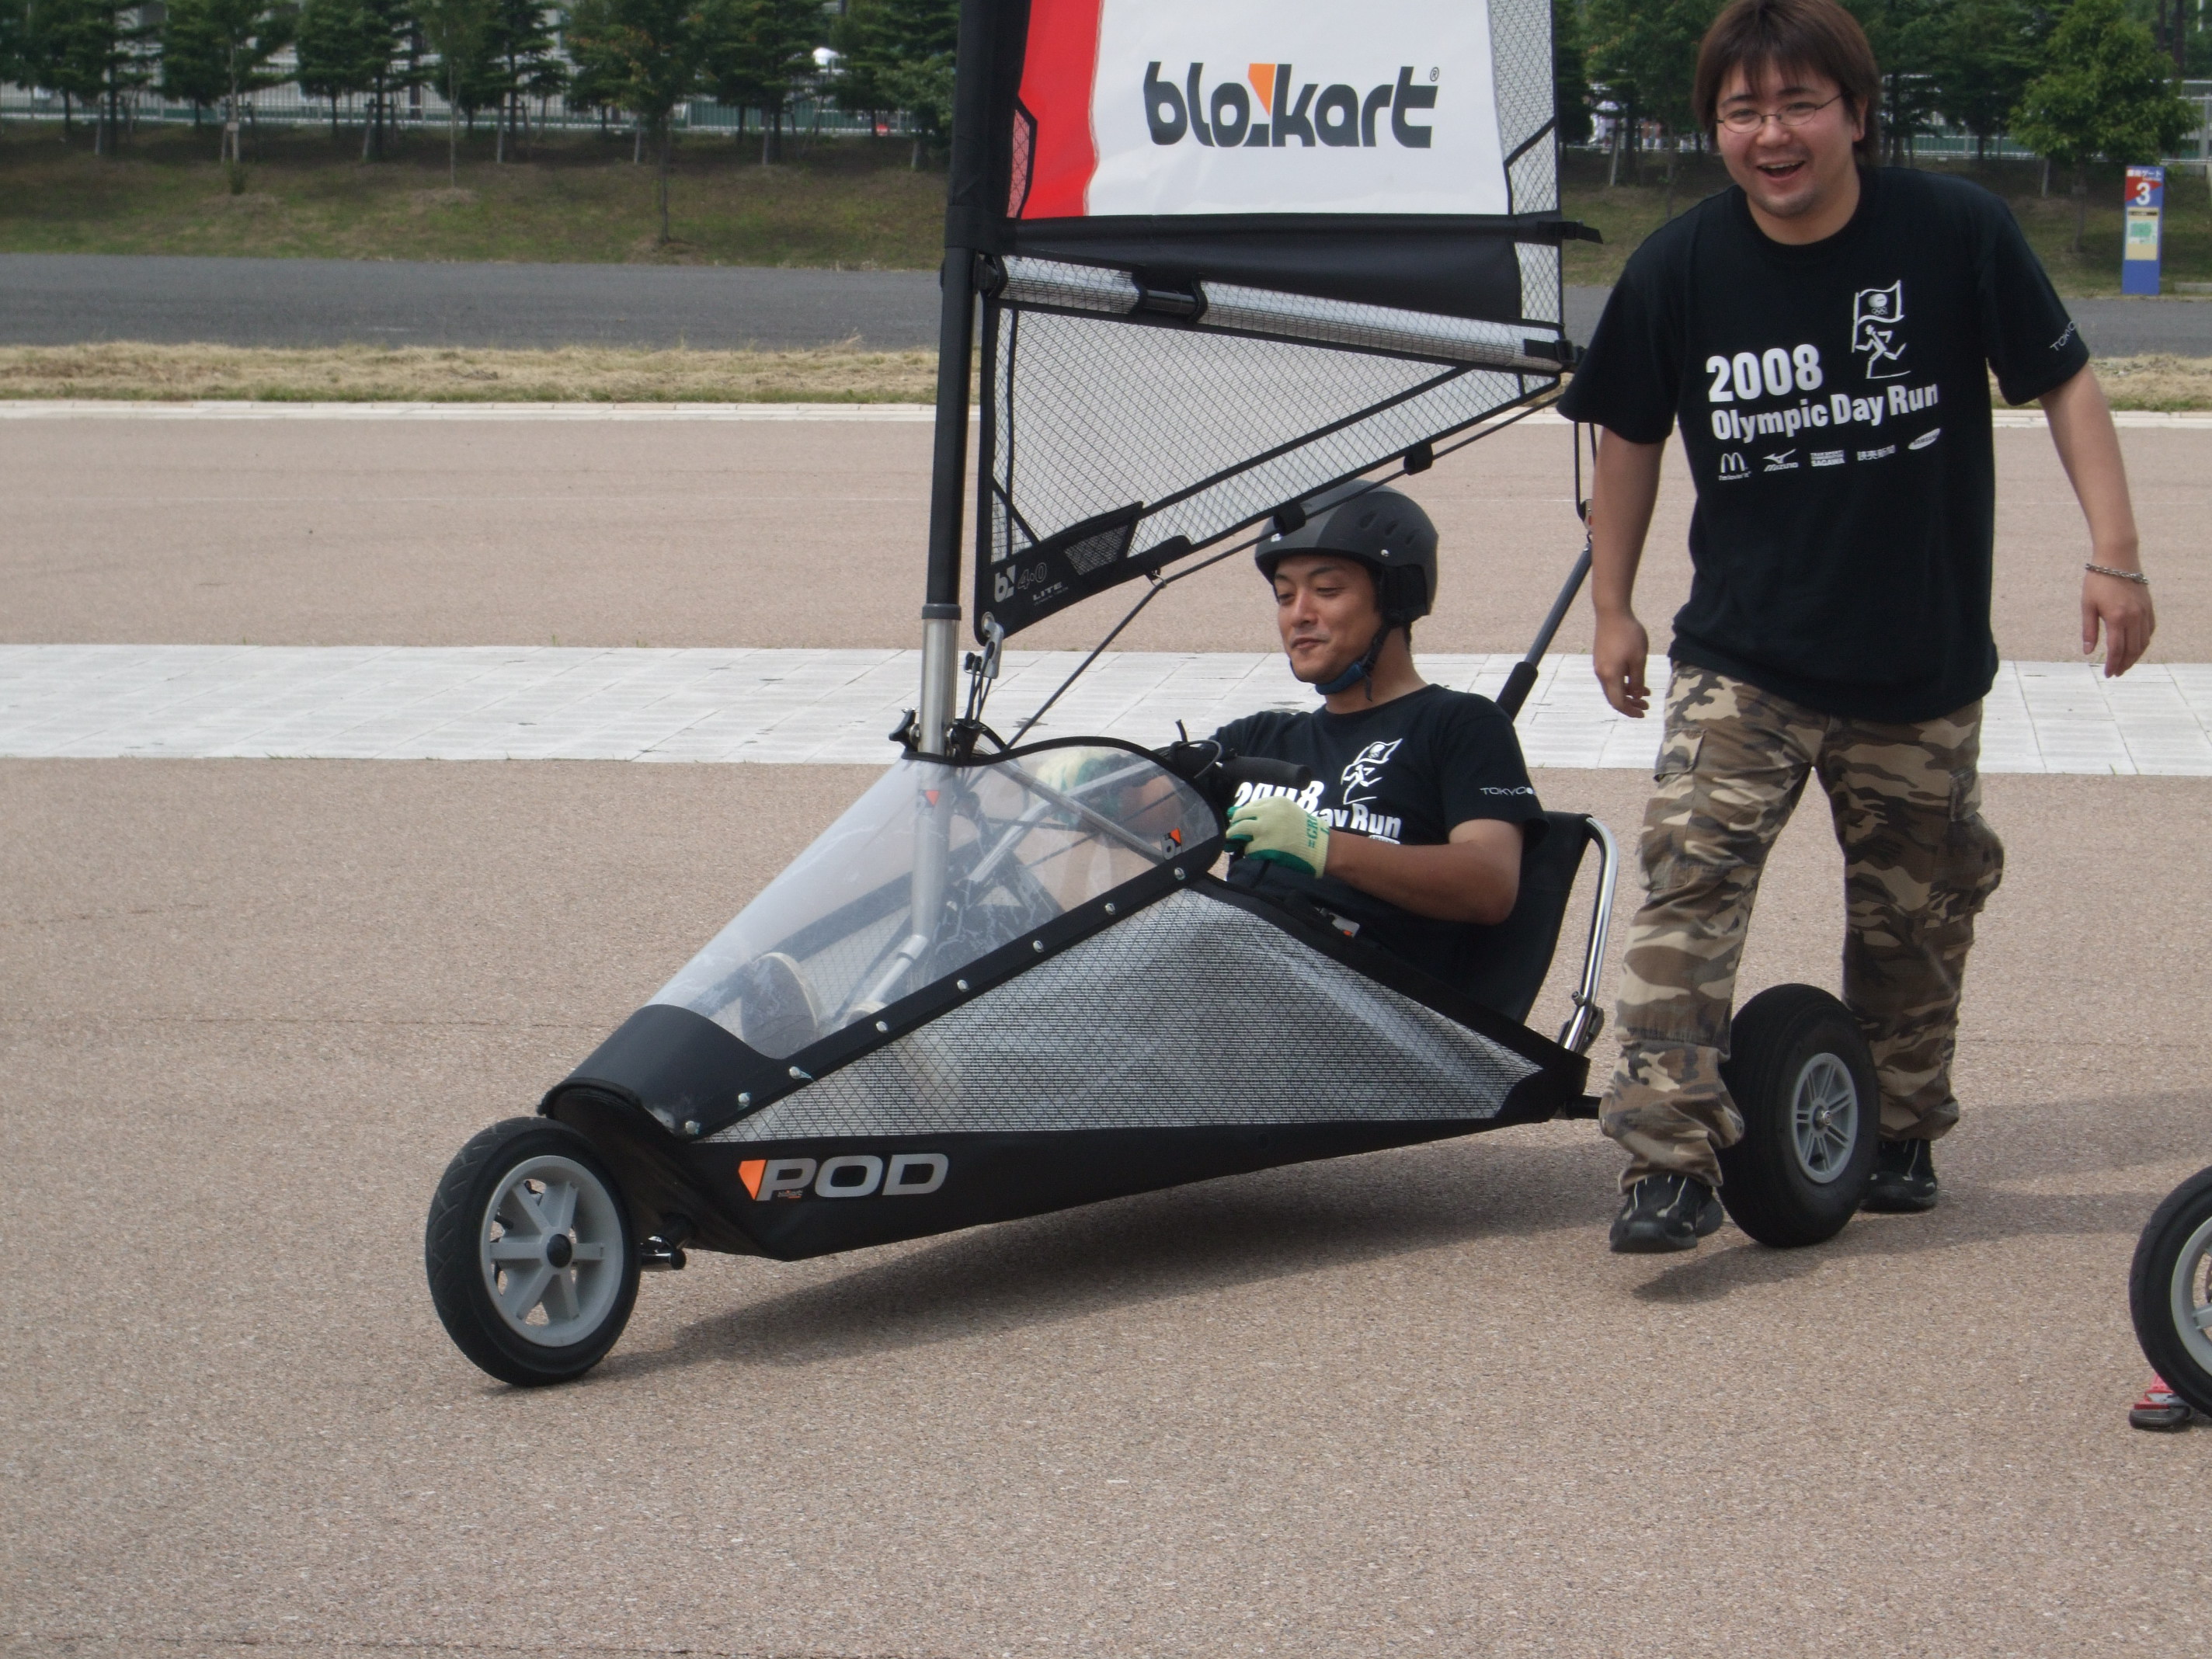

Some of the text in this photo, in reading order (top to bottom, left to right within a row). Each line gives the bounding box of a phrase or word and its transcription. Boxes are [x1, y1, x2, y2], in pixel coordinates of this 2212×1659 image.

[1143, 61, 1438, 148] blokart
[2137, 183, 2151, 205] 3
[1706, 343, 1824, 402] 2008
[1711, 384, 1939, 443] Olympic Day Run
[1033, 582, 1063, 601] LITE
[1312, 803, 1401, 839] ay Run
[756, 1153, 949, 1202] POD
